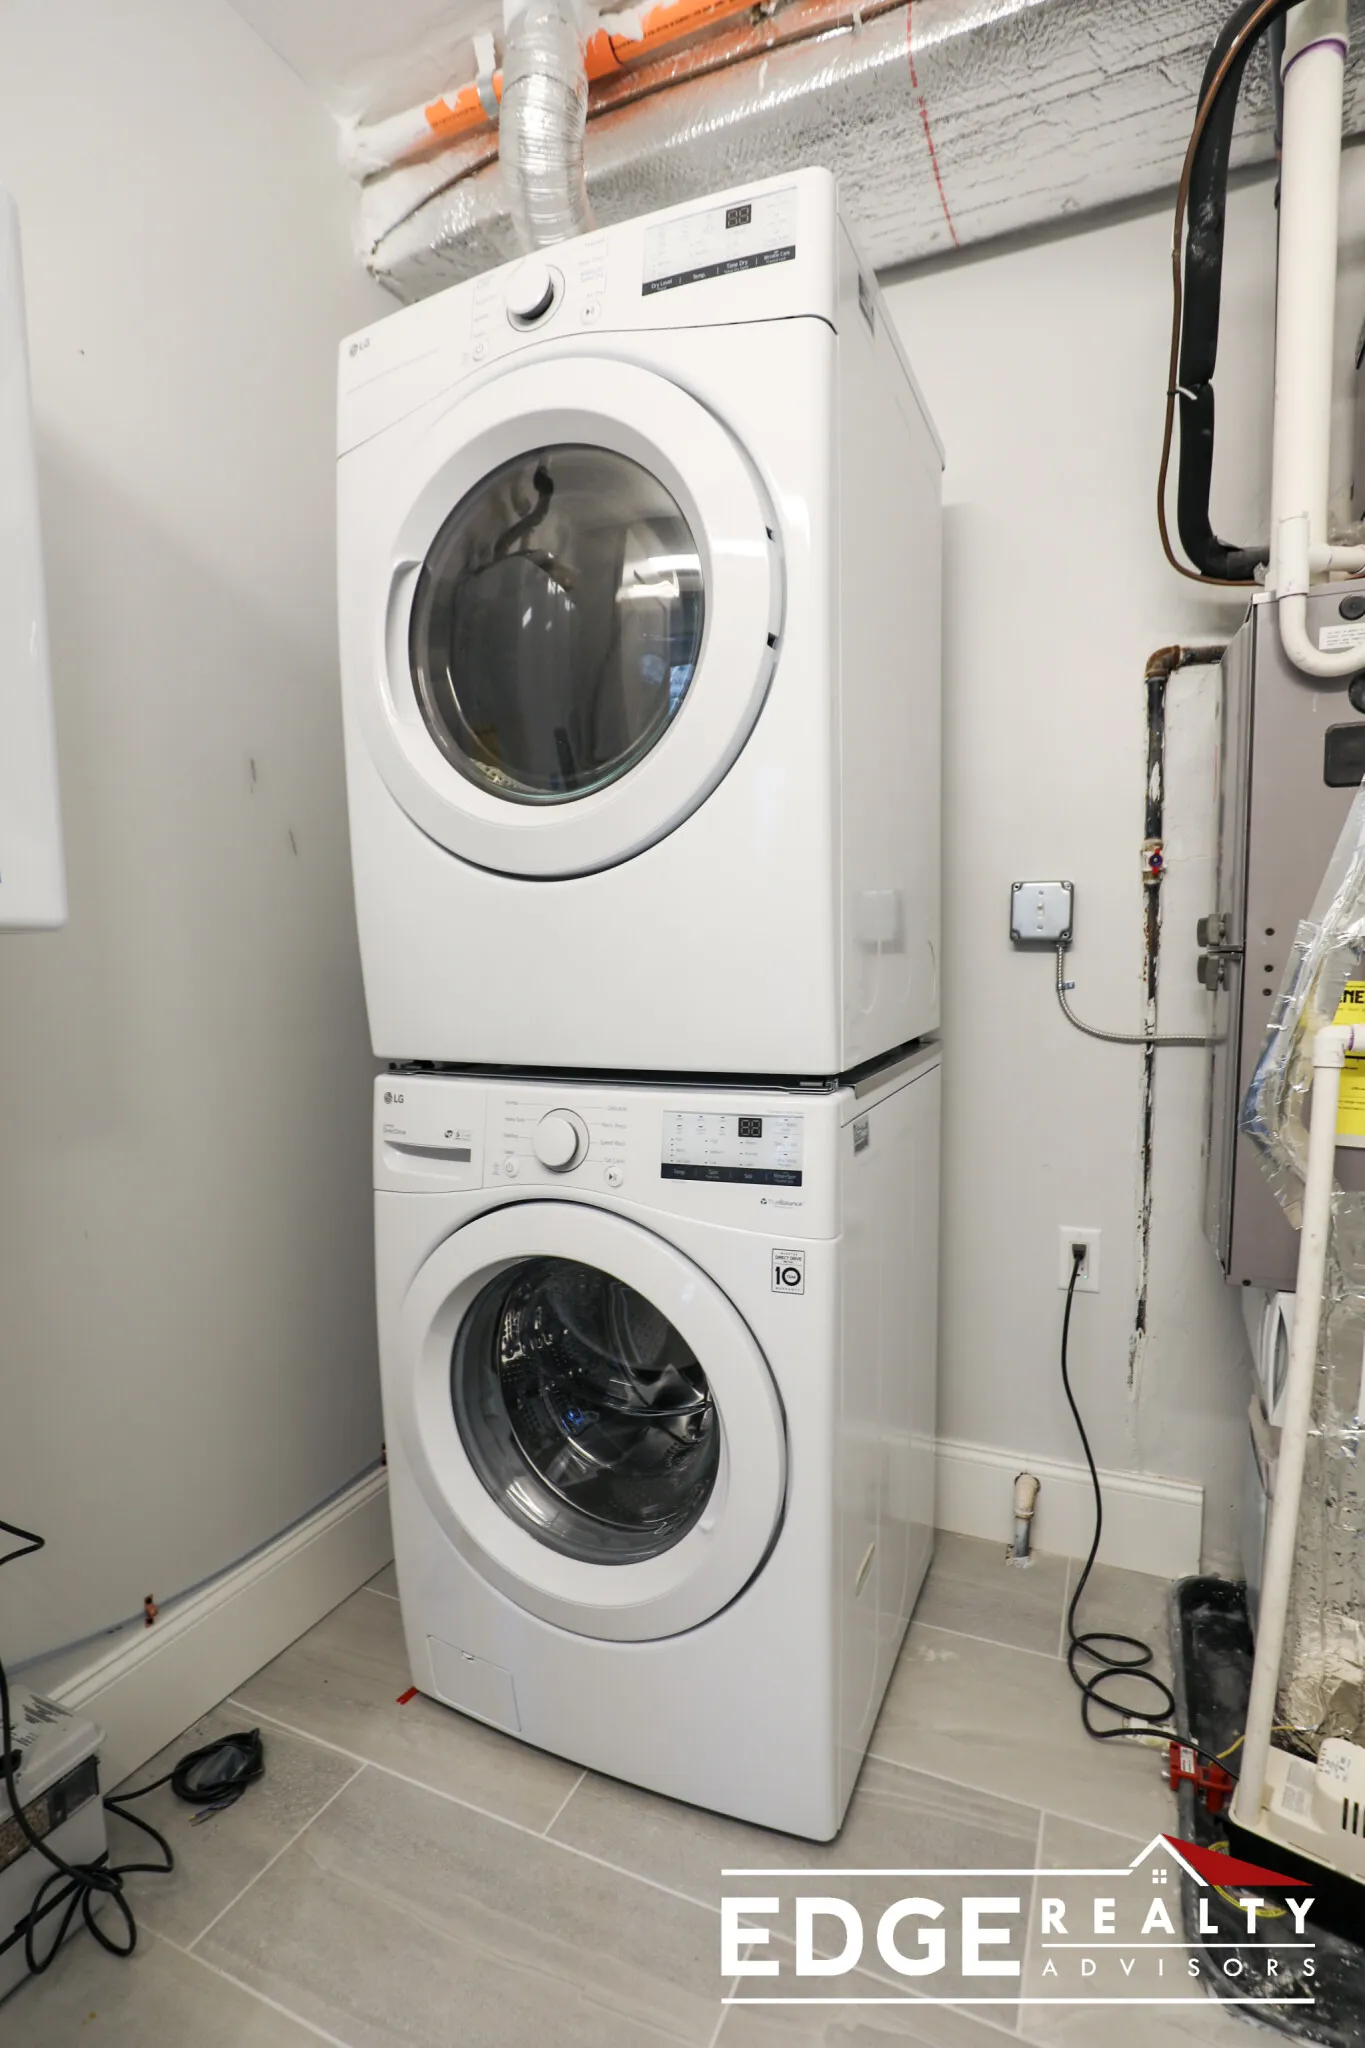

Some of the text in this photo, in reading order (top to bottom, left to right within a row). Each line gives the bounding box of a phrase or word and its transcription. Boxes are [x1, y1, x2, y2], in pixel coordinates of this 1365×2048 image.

[726, 259, 748, 269] Time Dry
[651, 282, 660, 290] Dry
[660, 278, 673, 287] Level
[775, 1266, 802, 1287] 10
